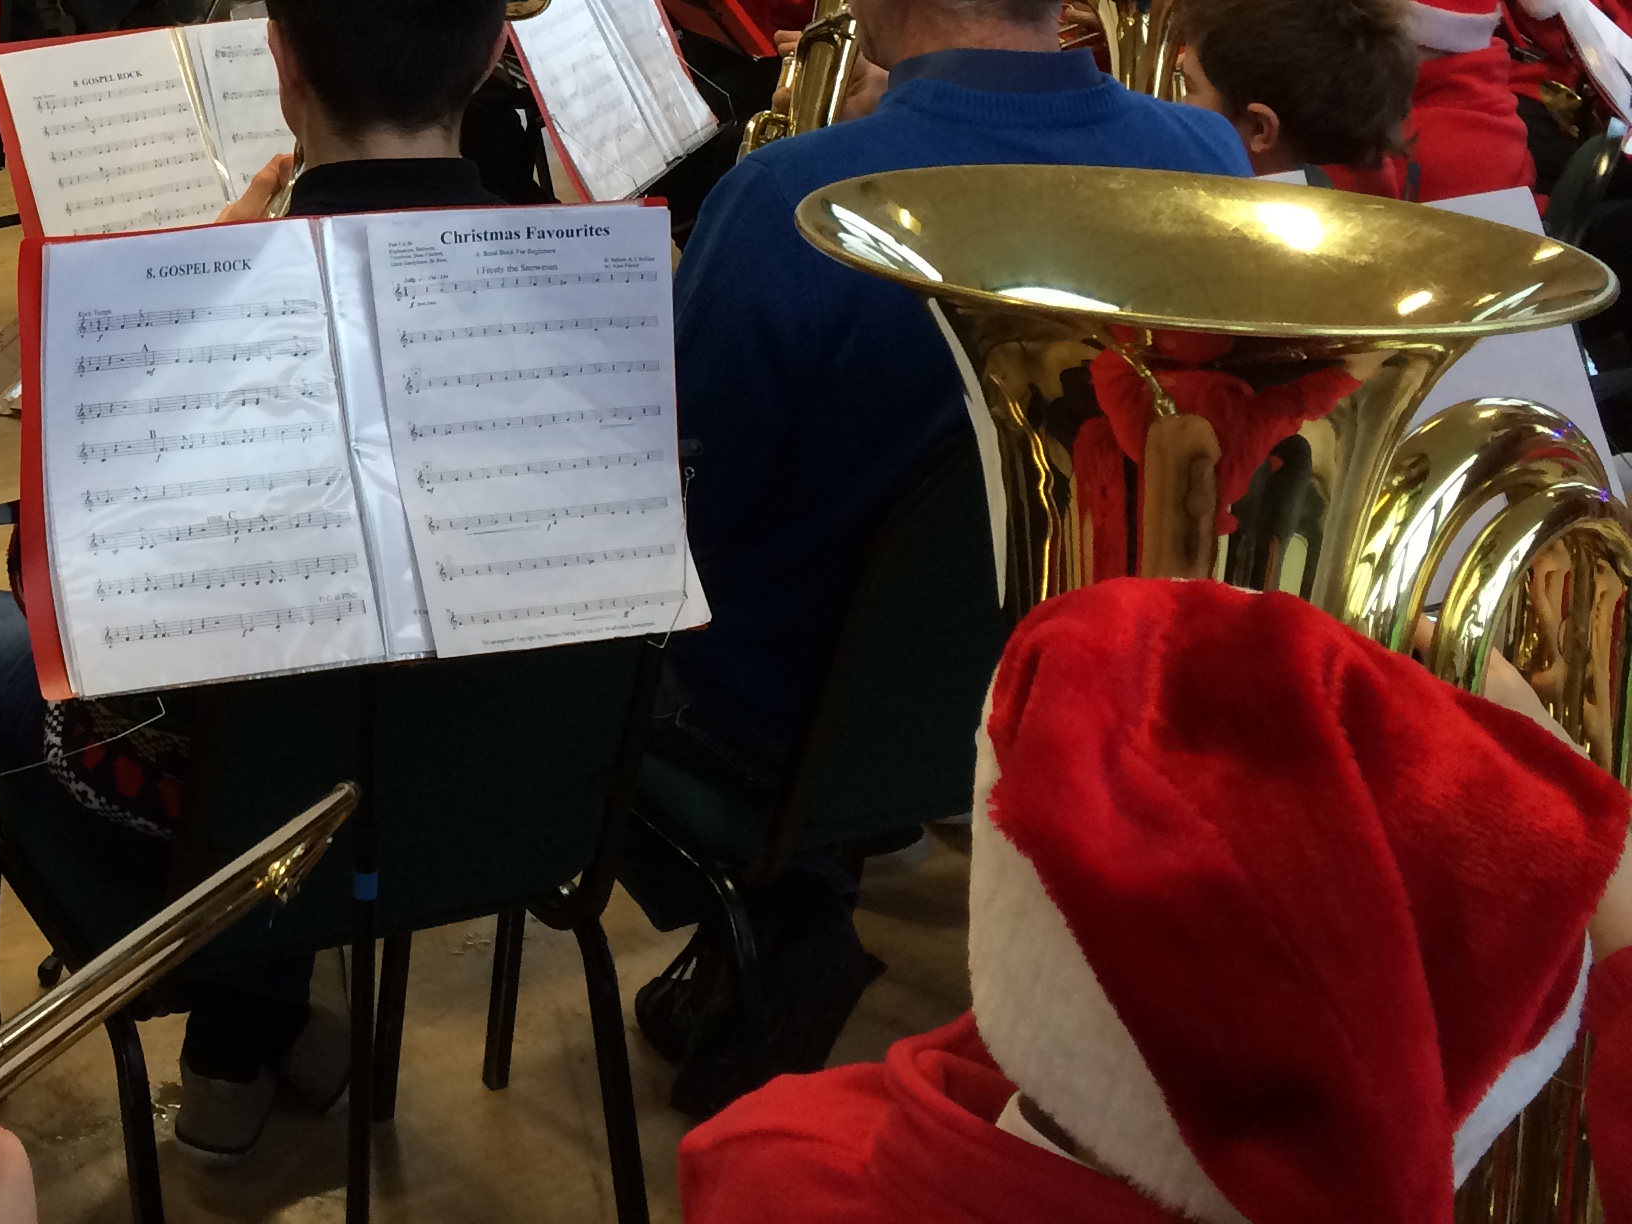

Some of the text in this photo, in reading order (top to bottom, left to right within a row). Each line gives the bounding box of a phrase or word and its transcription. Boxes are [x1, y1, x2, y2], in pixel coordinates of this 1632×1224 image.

[81, 74, 115, 86] GOSPEL
[116, 70, 143, 80] ROCK
[440, 224, 611, 245] Christmas Favourites
[146, 258, 252, 279] 8. GOSPEL ROCK
[507, 264, 519, 272] the
[520, 263, 558, 273] Snowman
[228, 510, 236, 520] C
